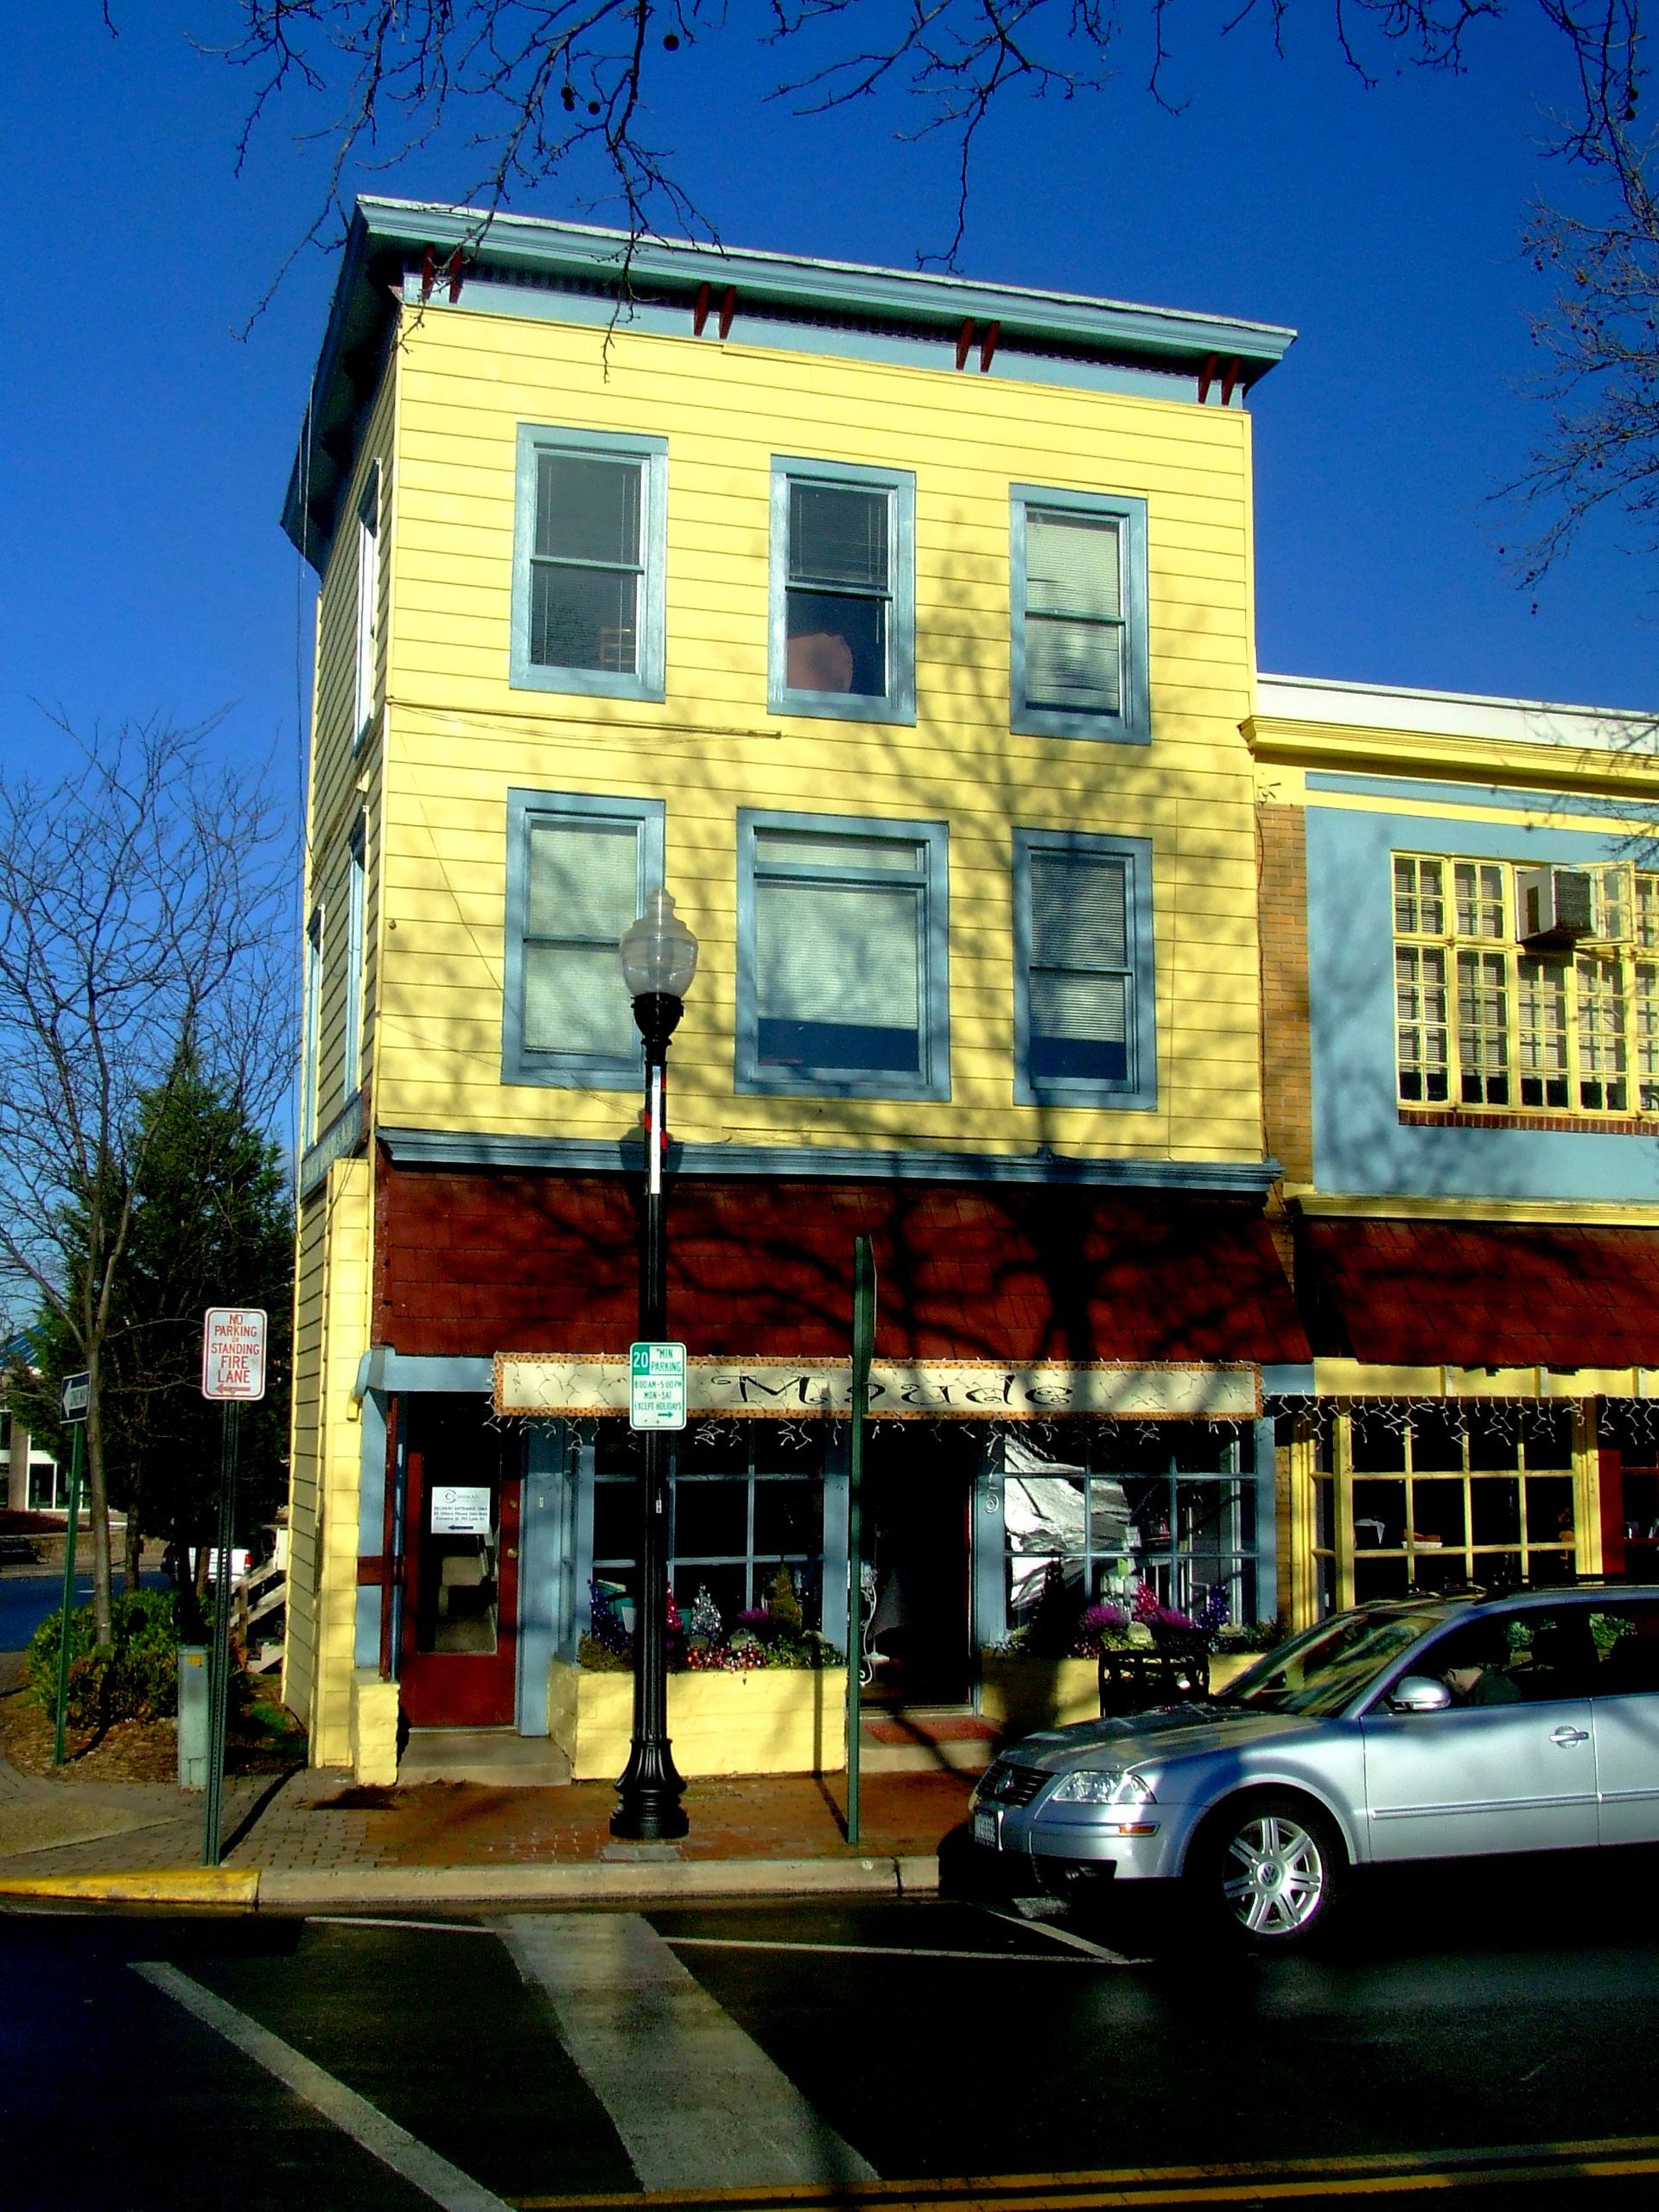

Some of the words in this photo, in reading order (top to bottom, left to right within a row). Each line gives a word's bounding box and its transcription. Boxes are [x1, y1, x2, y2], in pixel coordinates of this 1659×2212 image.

[229, 1314, 243, 1325] NO
[214, 1325, 257, 1338] PARKING
[211, 1343, 260, 1356] STANDING
[221, 1356, 249, 1370] FIRE
[633, 1351, 649, 1369] 20
[659, 1348, 673, 1359] MIN
[651, 1361, 682, 1372] PARKING
[218, 1370, 251, 1383] LANE
[634, 1402, 654, 1410] EXCEPT
[656, 1402, 682, 1410] HOLIDAYS
